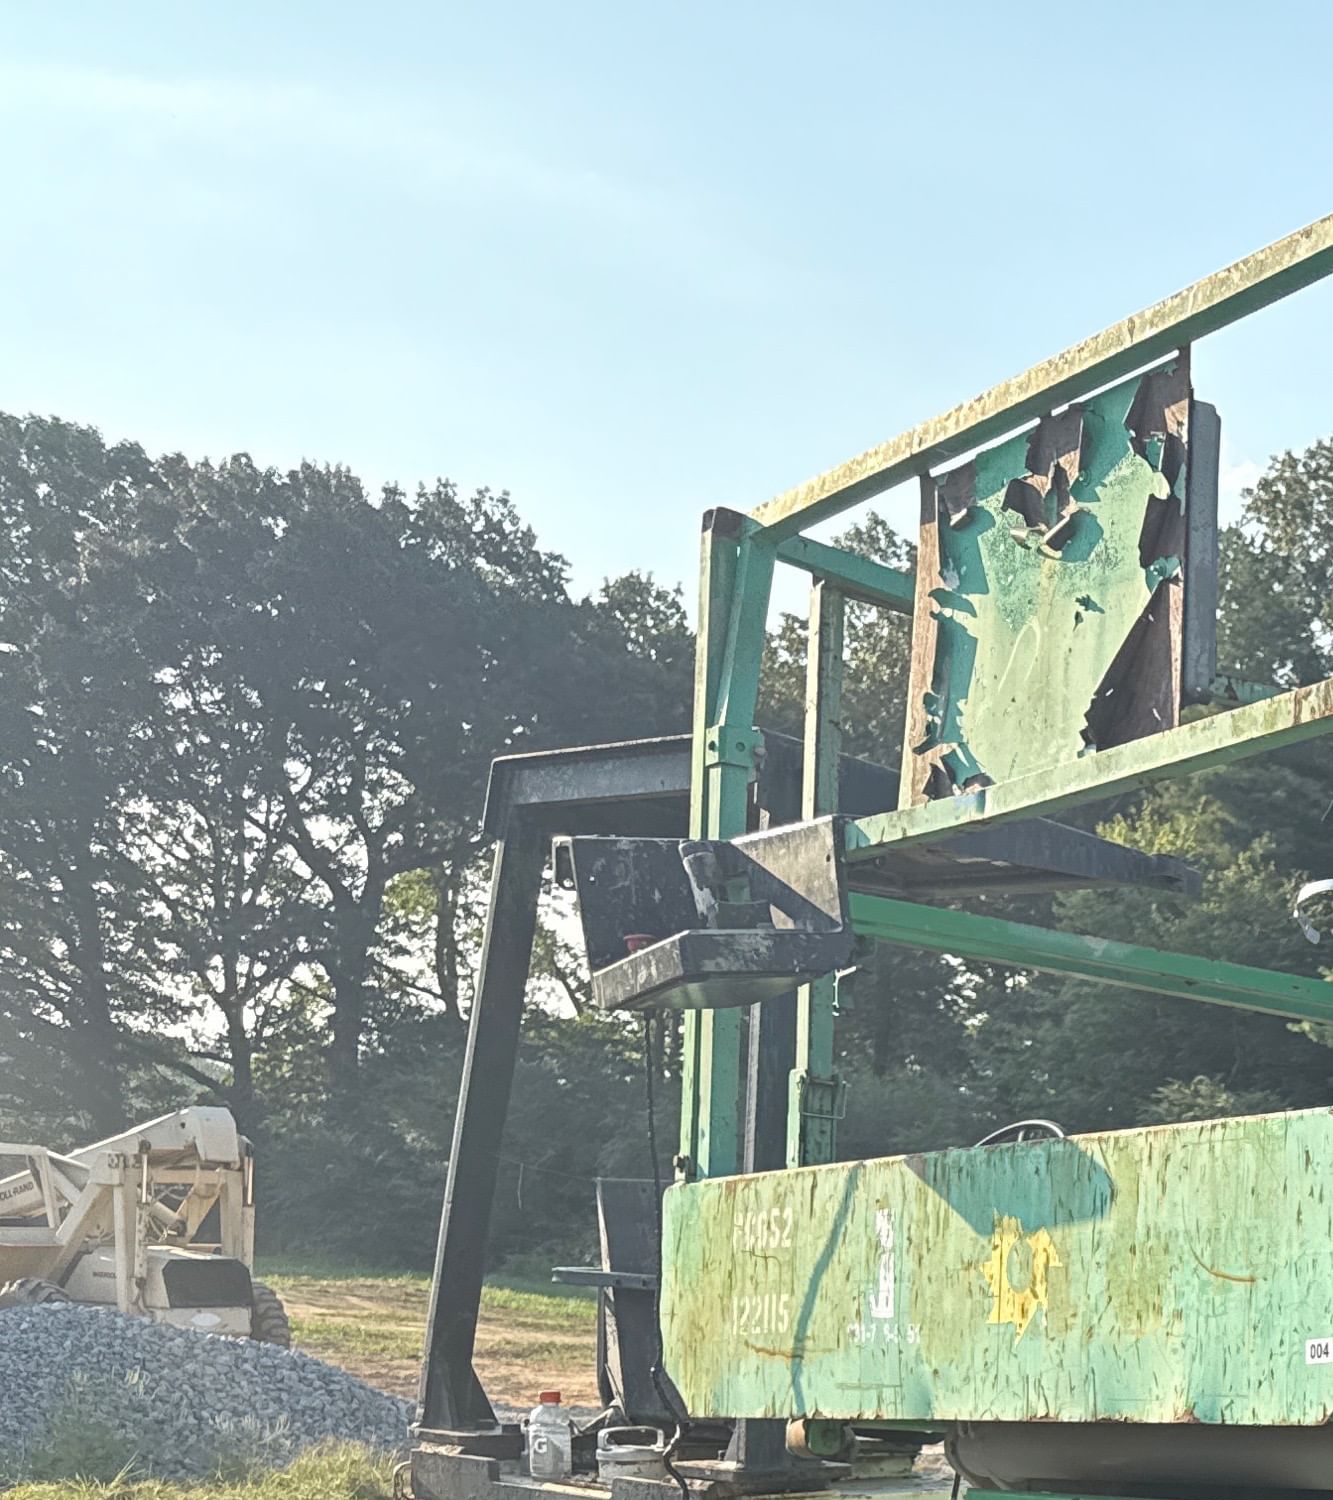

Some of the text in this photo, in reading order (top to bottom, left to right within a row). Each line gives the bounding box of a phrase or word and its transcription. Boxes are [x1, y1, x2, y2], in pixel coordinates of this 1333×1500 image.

[732, 1293, 790, 1336] 122115
[1310, 1342, 1330, 1359] 004
[534, 1437, 548, 1453] G
